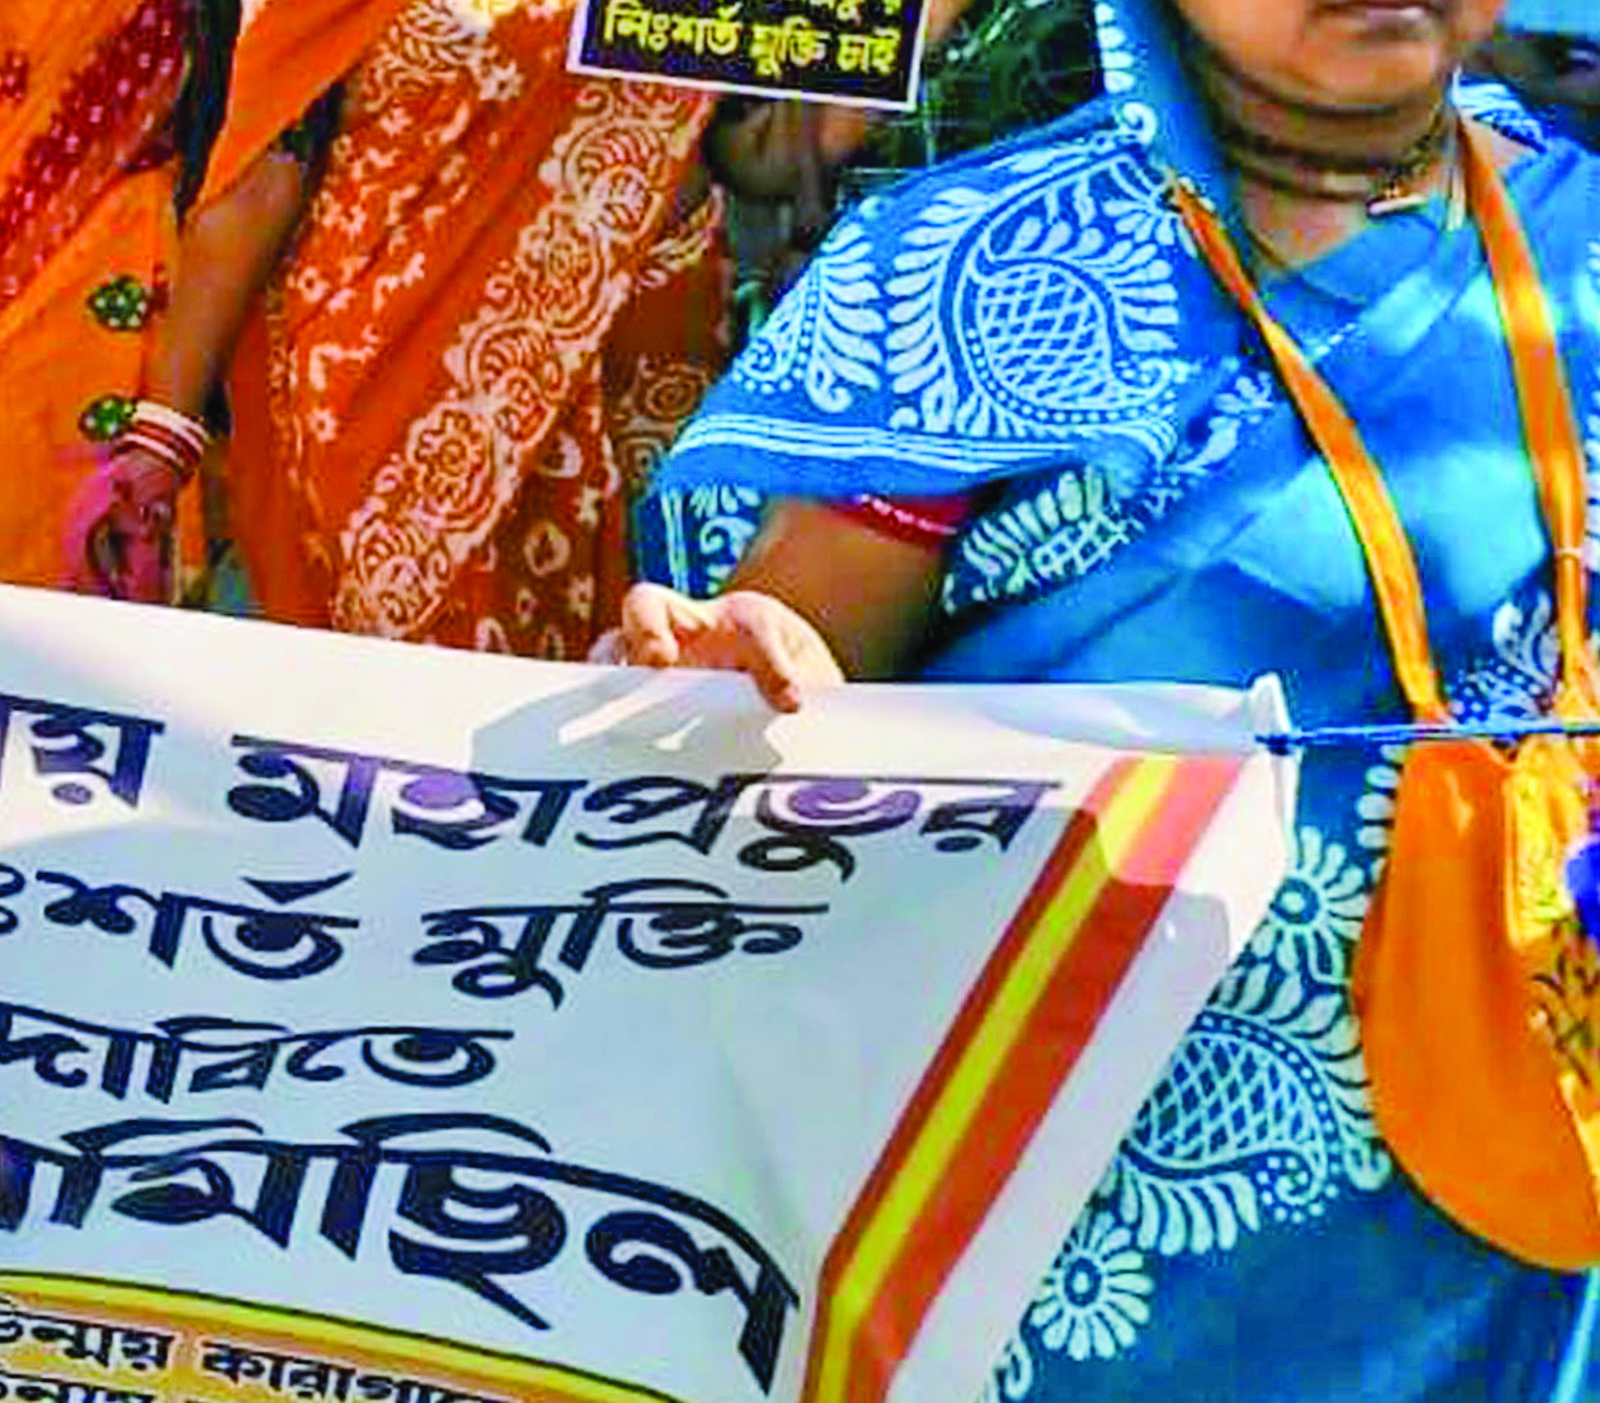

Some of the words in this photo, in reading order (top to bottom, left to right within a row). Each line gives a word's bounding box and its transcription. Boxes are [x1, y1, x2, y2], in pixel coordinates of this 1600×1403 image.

[750, 15, 831, 81] মুক্তি
[836, 27, 901, 76] চাই
[228, 733, 1065, 885] মহাপ্রভুর
[412, 881, 826, 1011] মুক্তি
